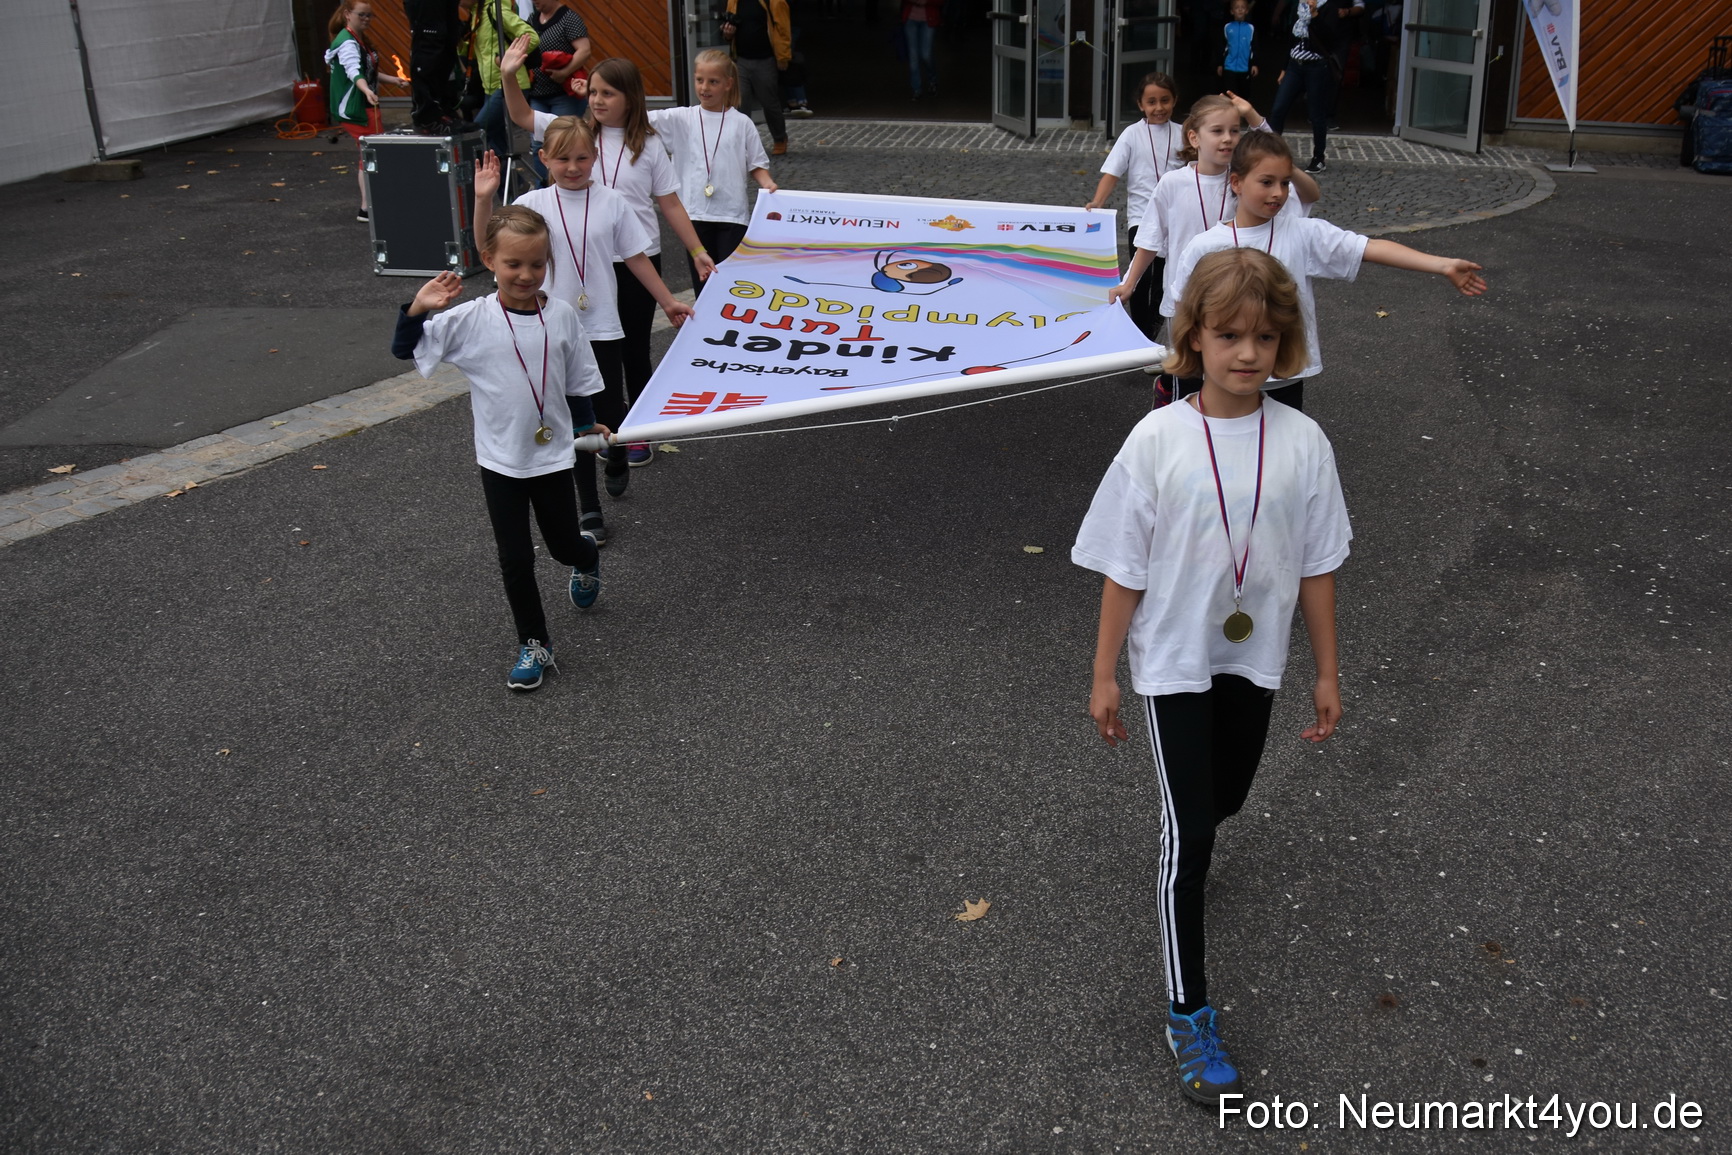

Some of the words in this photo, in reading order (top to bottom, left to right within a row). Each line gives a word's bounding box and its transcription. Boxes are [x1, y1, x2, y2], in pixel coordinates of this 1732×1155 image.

[786, 214, 900, 229] NEUMARKT
[1019, 224, 1076, 233] BTV
[720, 303, 885, 341] Turn
[703, 329, 957, 363] Kinder
[690, 358, 849, 378] Bayerische
